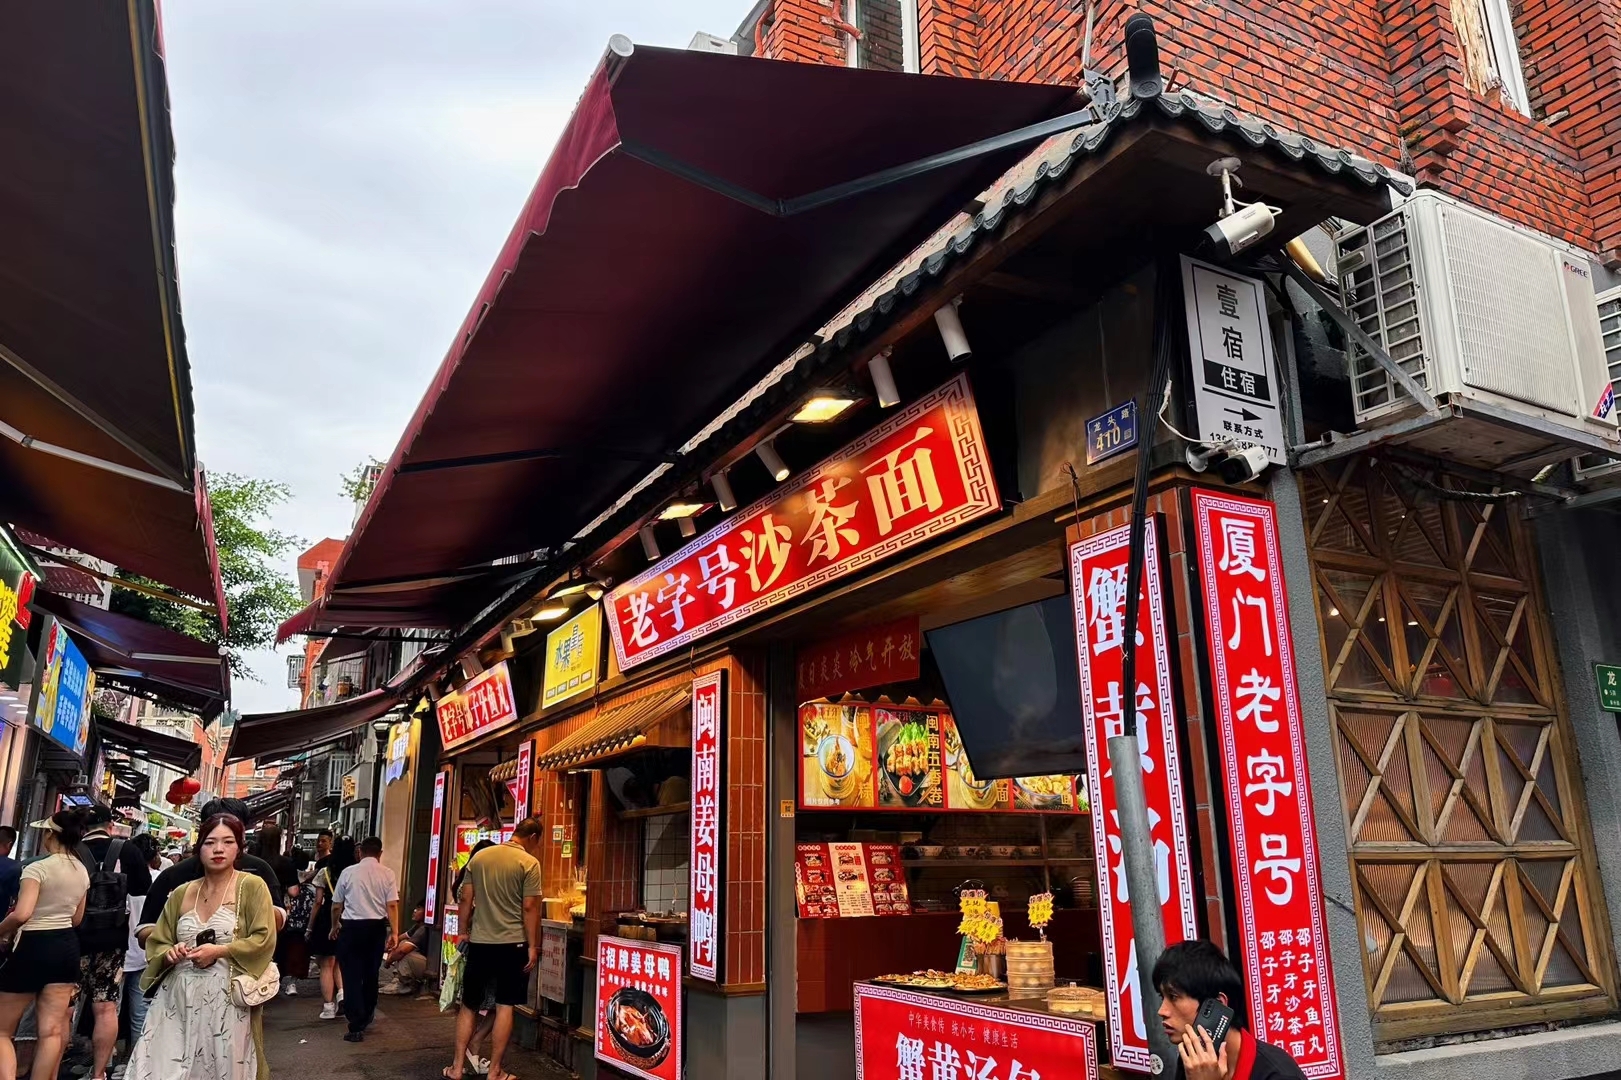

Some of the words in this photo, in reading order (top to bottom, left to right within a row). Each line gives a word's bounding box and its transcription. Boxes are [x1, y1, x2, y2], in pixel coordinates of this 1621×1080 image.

[1570, 264, 1588, 278] GREE
[1217, 284, 1244, 361] 壹宿
[1220, 366, 1256, 396] 住宿
[1093, 408, 1129, 432] 龙头路
[1096, 426, 1121, 451] 410
[1223, 420, 1264, 440] 联系方式
[622, 426, 944, 648] 老字号沙茶面
[1219, 517, 1301, 906] 厦门老字号
[926, 714, 943, 805] 闽南五香卷
[693, 692, 716, 963] 闽南姜母鸭
[606, 946, 671, 981] 招牌姜母鸭
[1296, 928, 1324, 1054] 邵子牙鱼丸
[1278, 929, 1305, 1057] 邵子牙沙茶面
[908, 1011, 945, 1034] 中华美食传
[951, 1019, 976, 1041] 统小吃
[983, 1027, 1019, 1049] 健康生活
